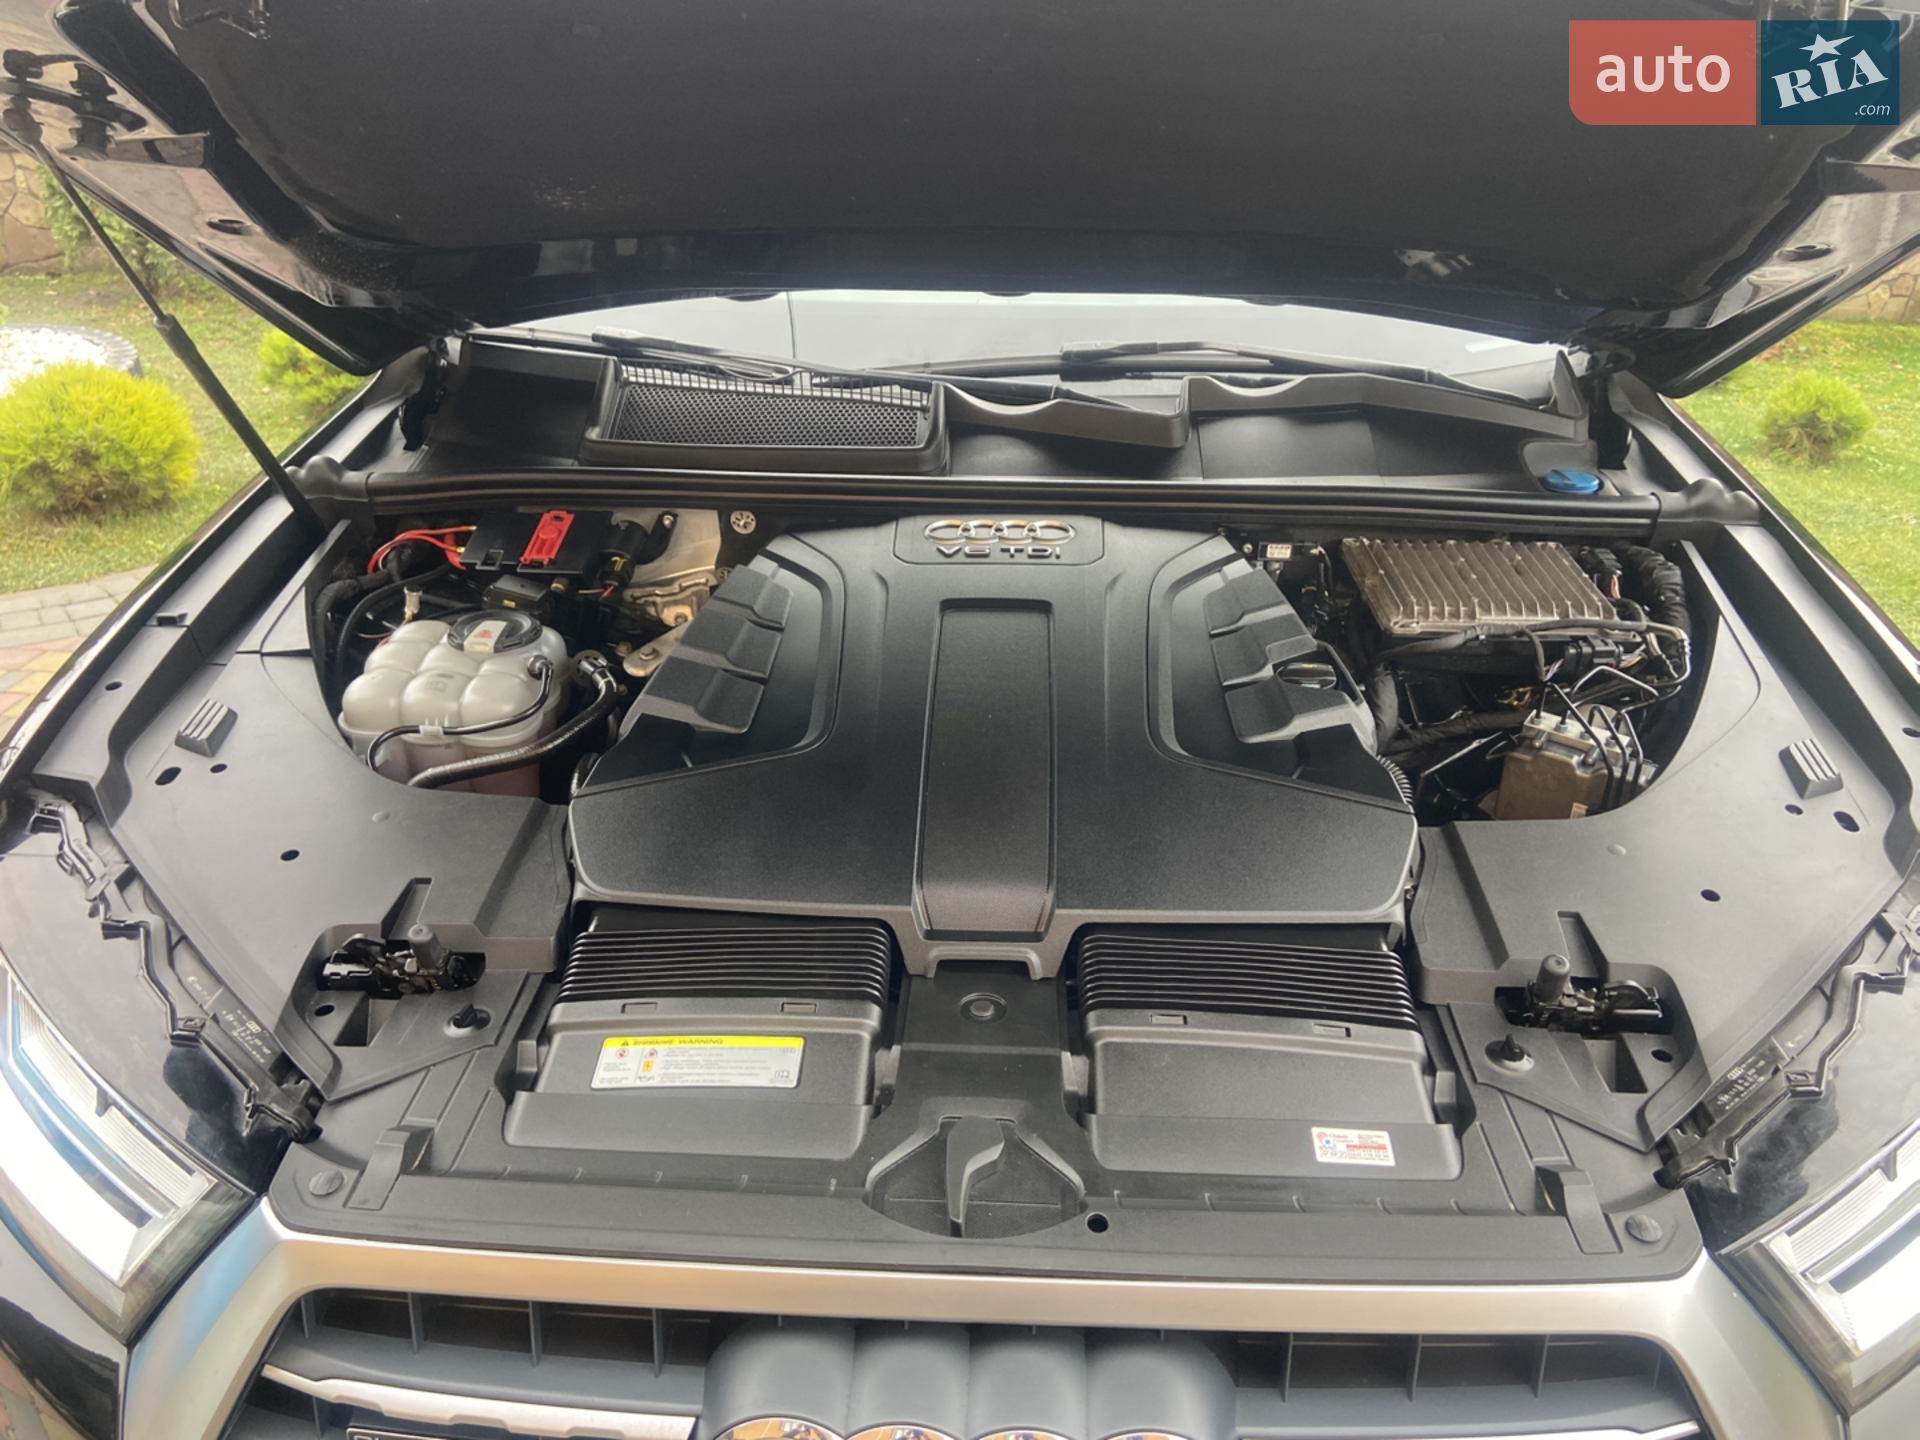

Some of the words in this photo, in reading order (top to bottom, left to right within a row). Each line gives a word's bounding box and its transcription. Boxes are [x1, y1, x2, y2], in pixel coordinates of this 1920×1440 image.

[936, 545, 991, 558] V6
[1000, 546, 1061, 560] TDI
[678, 1038, 724, 1046] WARNING
